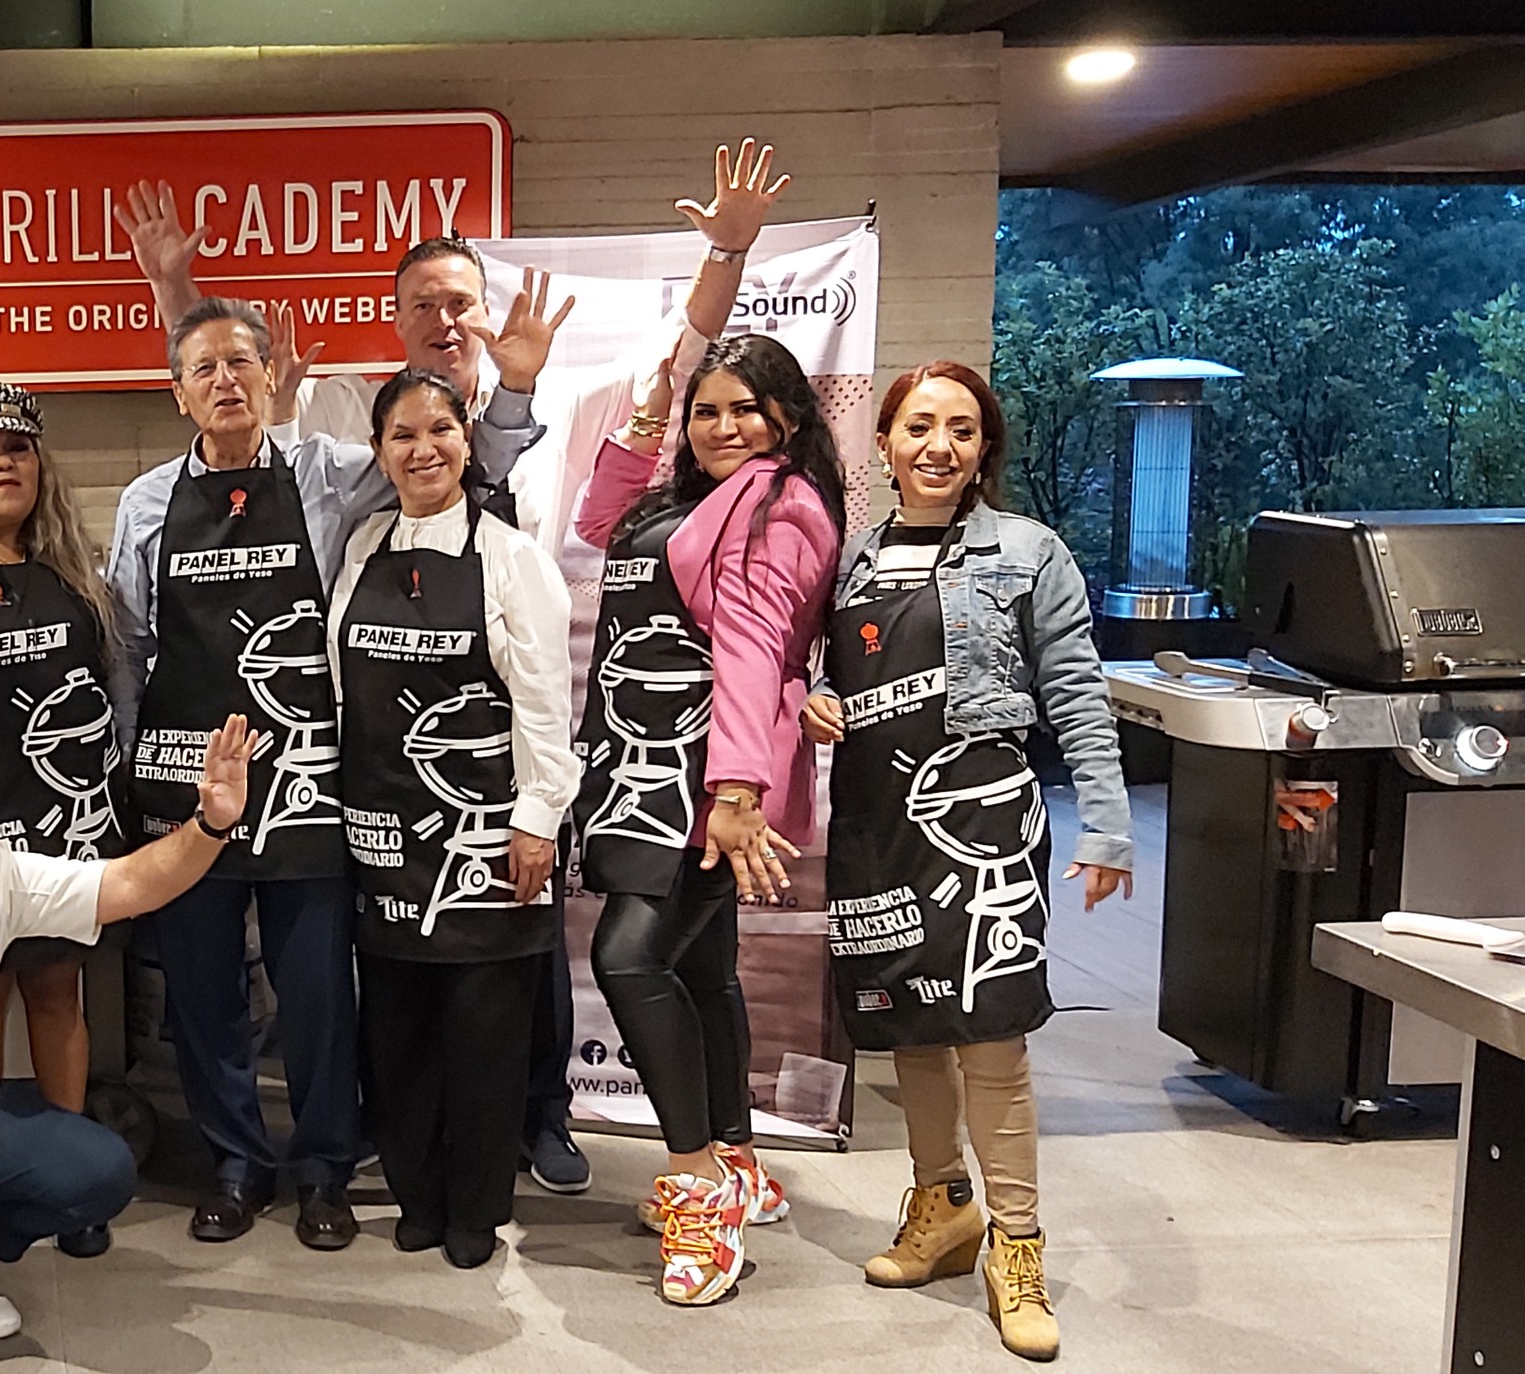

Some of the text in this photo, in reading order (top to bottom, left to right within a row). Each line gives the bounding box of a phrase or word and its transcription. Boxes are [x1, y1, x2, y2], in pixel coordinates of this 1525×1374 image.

[194, 178, 467, 257] CADEMY
[68, 302, 161, 332] ORIGI
[302, 296, 396, 324] WEBE
[733, 288, 827, 317] Sound
[178, 548, 288, 571] PANEL REY
[191, 569, 272, 583] Paneles de Yeso
[26, 628, 59, 647] REY
[356, 628, 464, 650] PANEL REY
[14, 654, 27, 664] de
[367, 650, 402, 661] Paneles
[403, 653, 415, 662] de
[844, 673, 937, 717] ANEL REY
[881, 711, 894, 720] de
[895, 701, 924, 715] Yeso
[141, 729, 157, 743] LA
[136, 746, 206, 768] DE HACE
[374, 895, 420, 922] Lite
[838, 885, 917, 915] EXPERIENCIA
[844, 904, 922, 939] HACERLO
[830, 927, 925, 956] EXTRAORDINARIO
[905, 975, 957, 1004] Lite
